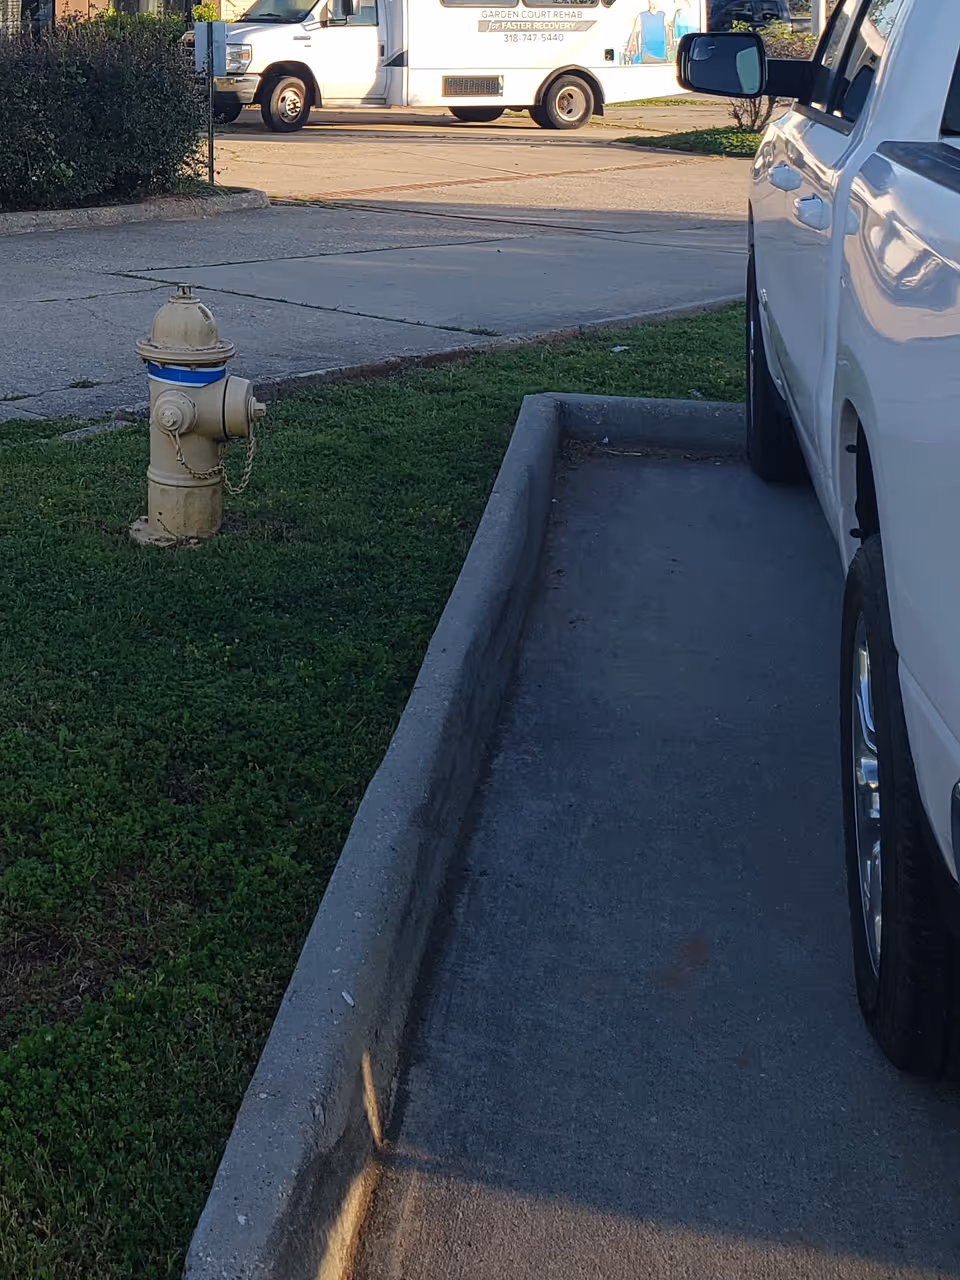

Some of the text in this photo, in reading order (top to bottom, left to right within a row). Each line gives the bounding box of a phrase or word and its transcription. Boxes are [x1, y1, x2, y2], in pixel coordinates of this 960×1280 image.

[482, 10, 583, 18] GARDEN COURT REHAB
[487, 20, 576, 32] for FASTER RECOVERY
[504, 34, 564, 42] 318-747-5440
